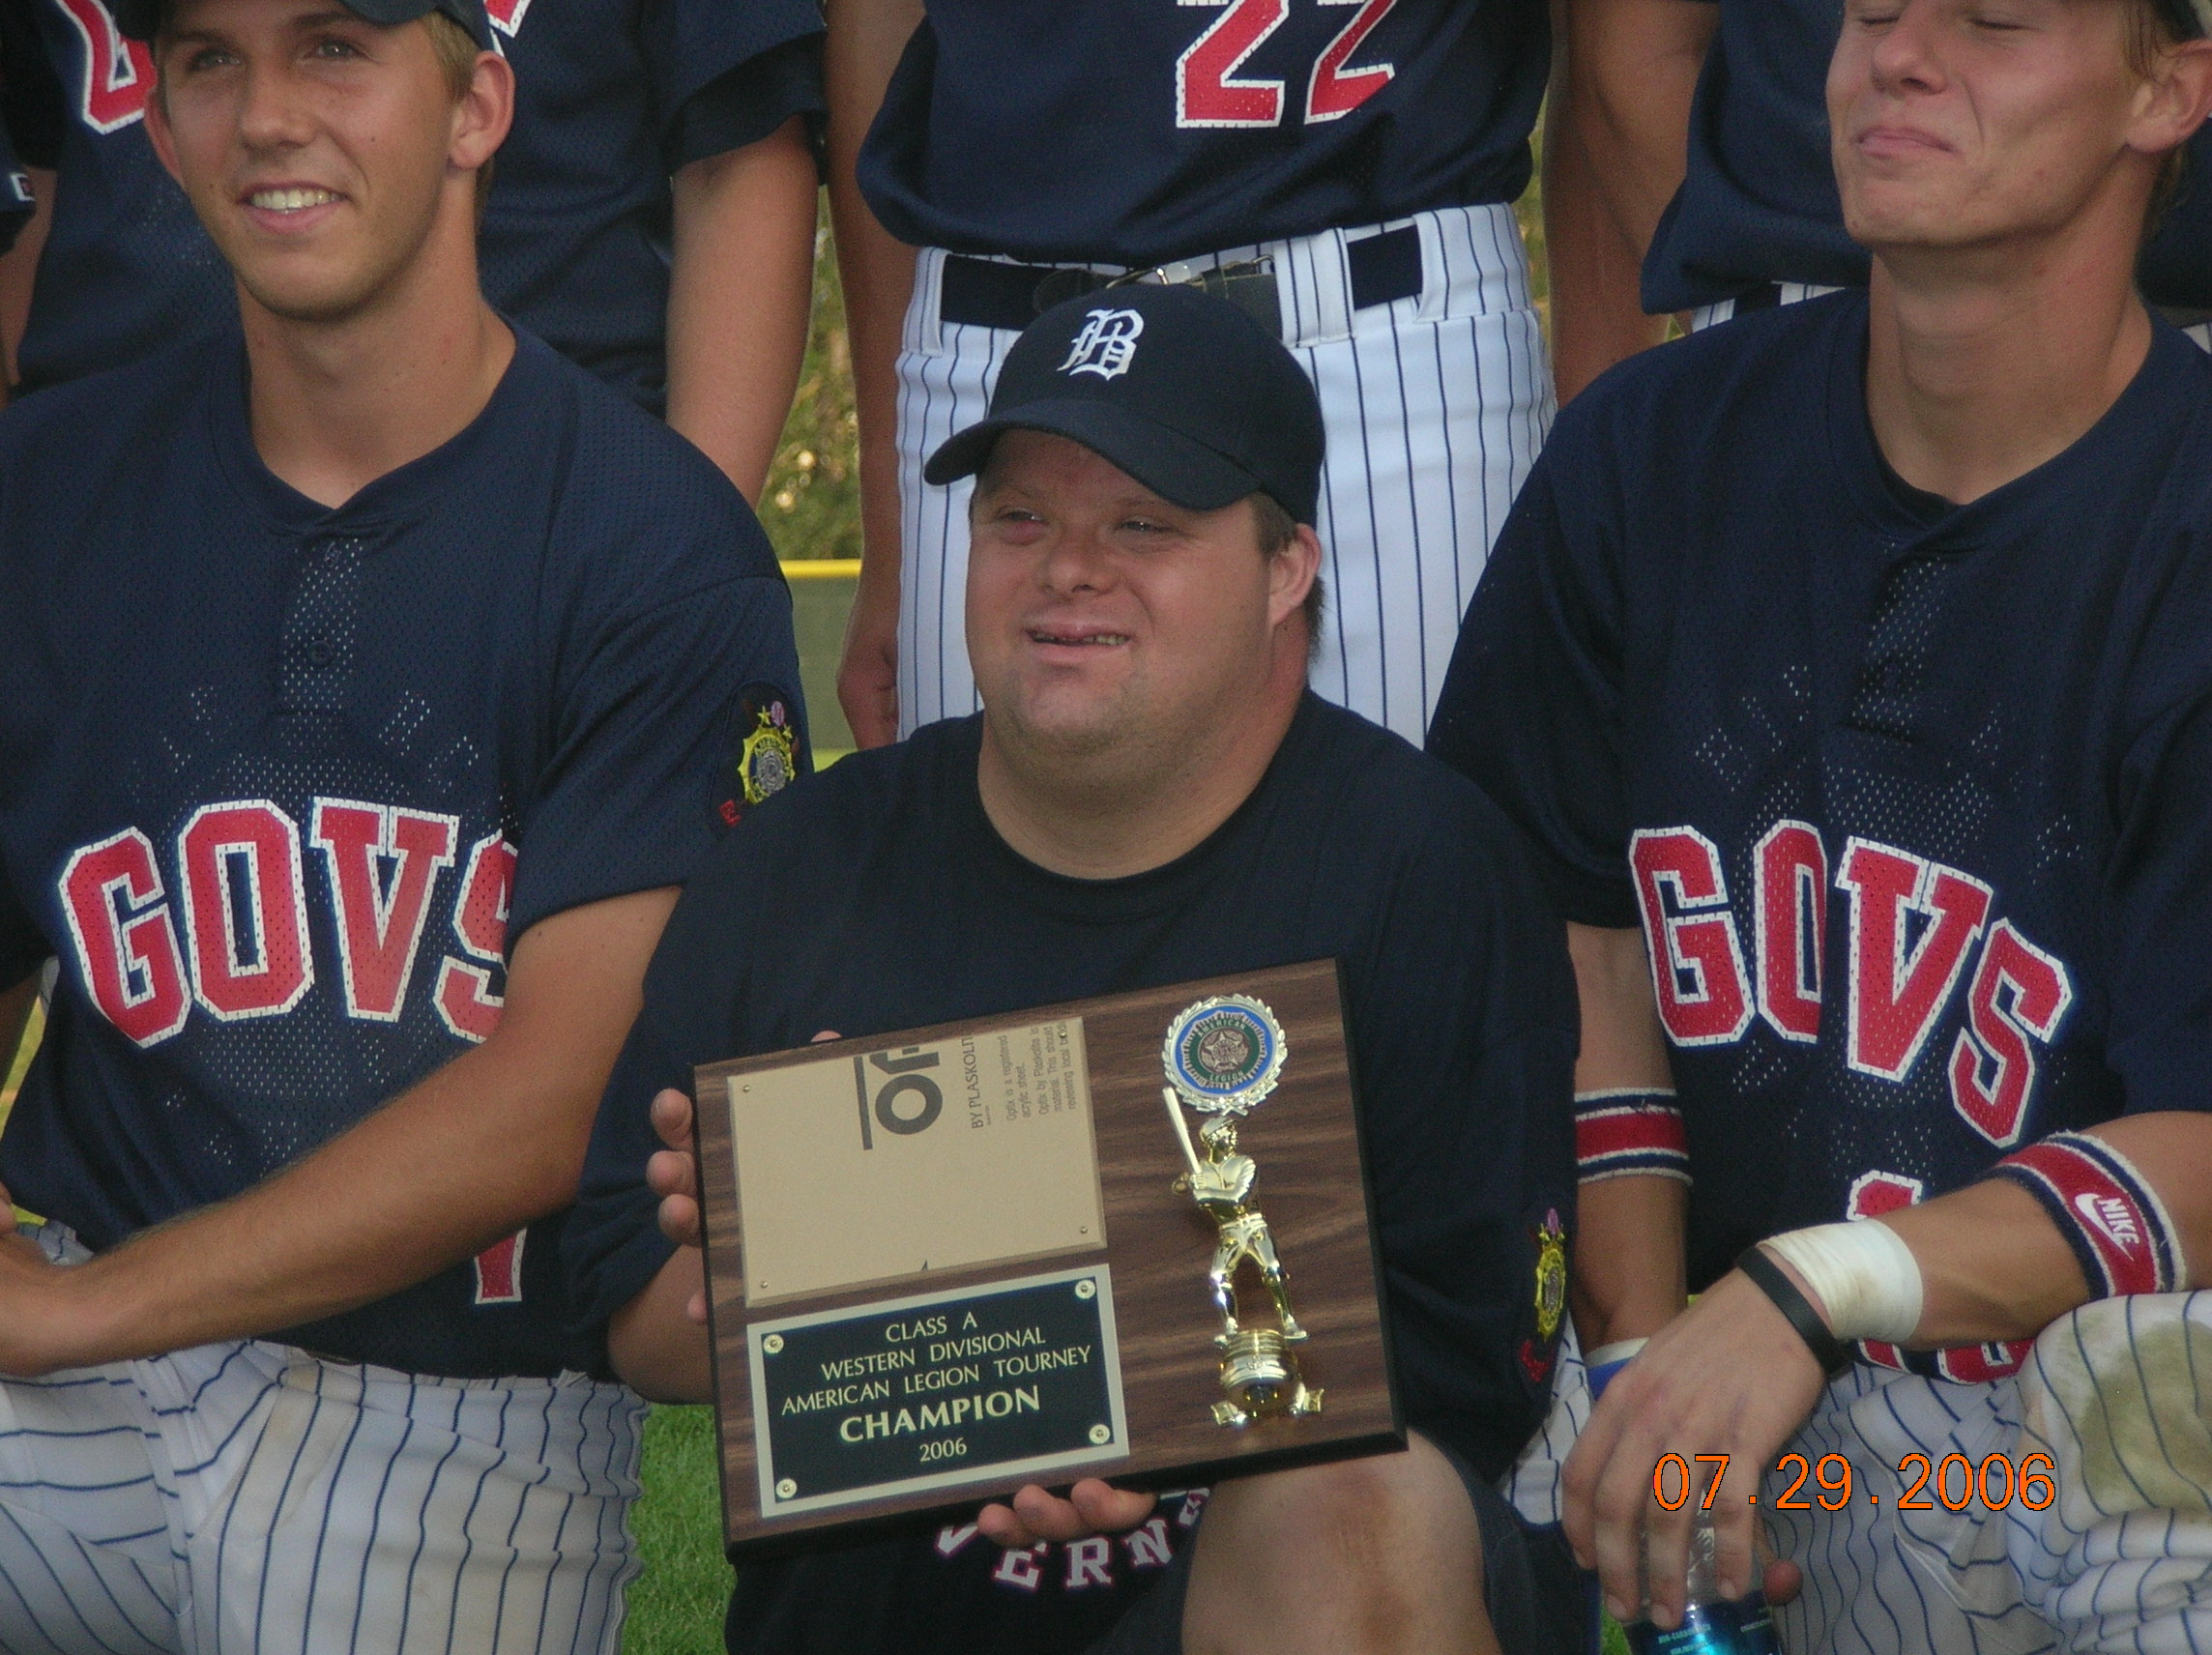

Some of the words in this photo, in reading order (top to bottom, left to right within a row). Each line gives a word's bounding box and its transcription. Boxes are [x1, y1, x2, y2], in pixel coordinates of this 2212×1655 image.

[1057, 308, 1144, 381] B
[58, 796, 520, 1049] GOVS
[1629, 819, 2073, 1148] GOVS
[1198, 1018, 1245, 1038] AMERICAN
[998, 1035, 1013, 1076] registered
[1031, 1038, 1044, 1077] Plaskolite
[1036, 1080, 1047, 1090] by
[1209, 1071, 1245, 1082] LEGION
[970, 1112, 984, 1129] BY
[1005, 1099, 1017, 1121] Optix
[2097, 1197, 2139, 1244] NIKE
[886, 1316, 947, 1344] CLASS
[962, 1311, 978, 1330] A
[821, 1349, 916, 1381] WESTERN
[930, 1326, 1046, 1363] DIVISIONAL
[781, 1379, 890, 1416] AMERICAN
[904, 1364, 979, 1395] LEGION
[993, 1345, 1091, 1379] TOURNEY
[839, 1384, 1041, 1443] CHAMPION
[919, 1437, 968, 1463] 2006
